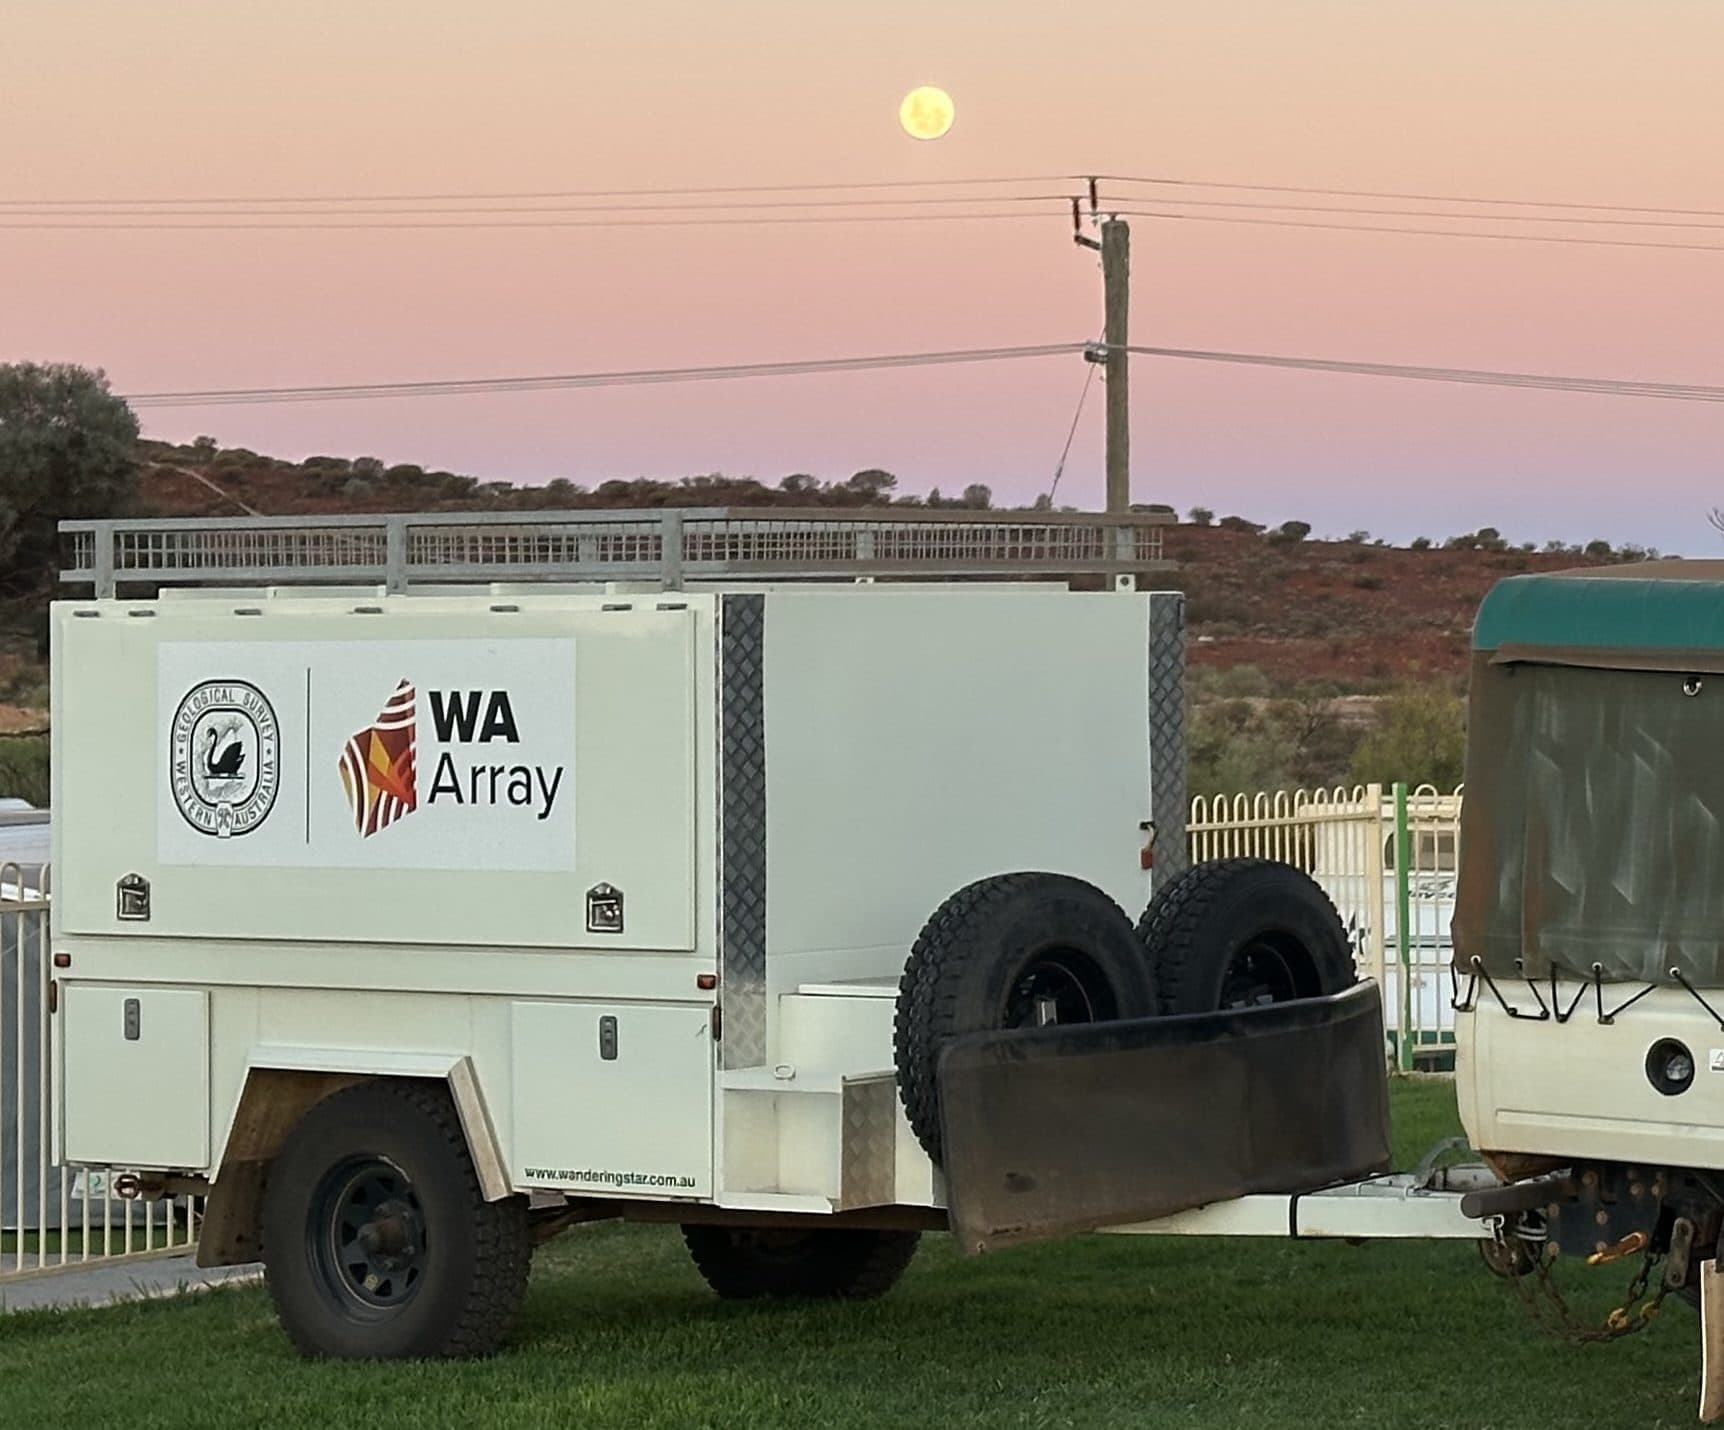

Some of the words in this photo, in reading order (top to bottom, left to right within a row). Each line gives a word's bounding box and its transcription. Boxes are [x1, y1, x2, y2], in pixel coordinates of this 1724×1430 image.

[177, 688, 236, 743] GEOLOGICAL
[243, 692, 274, 742] SURVEY
[428, 690, 520, 744] WA
[175, 760, 213, 826] WESTERN
[234, 760, 274, 826] AUSTRALIA
[427, 752, 564, 820] Array
[524, 1167, 696, 1188] www.wanderingstar.com.au
